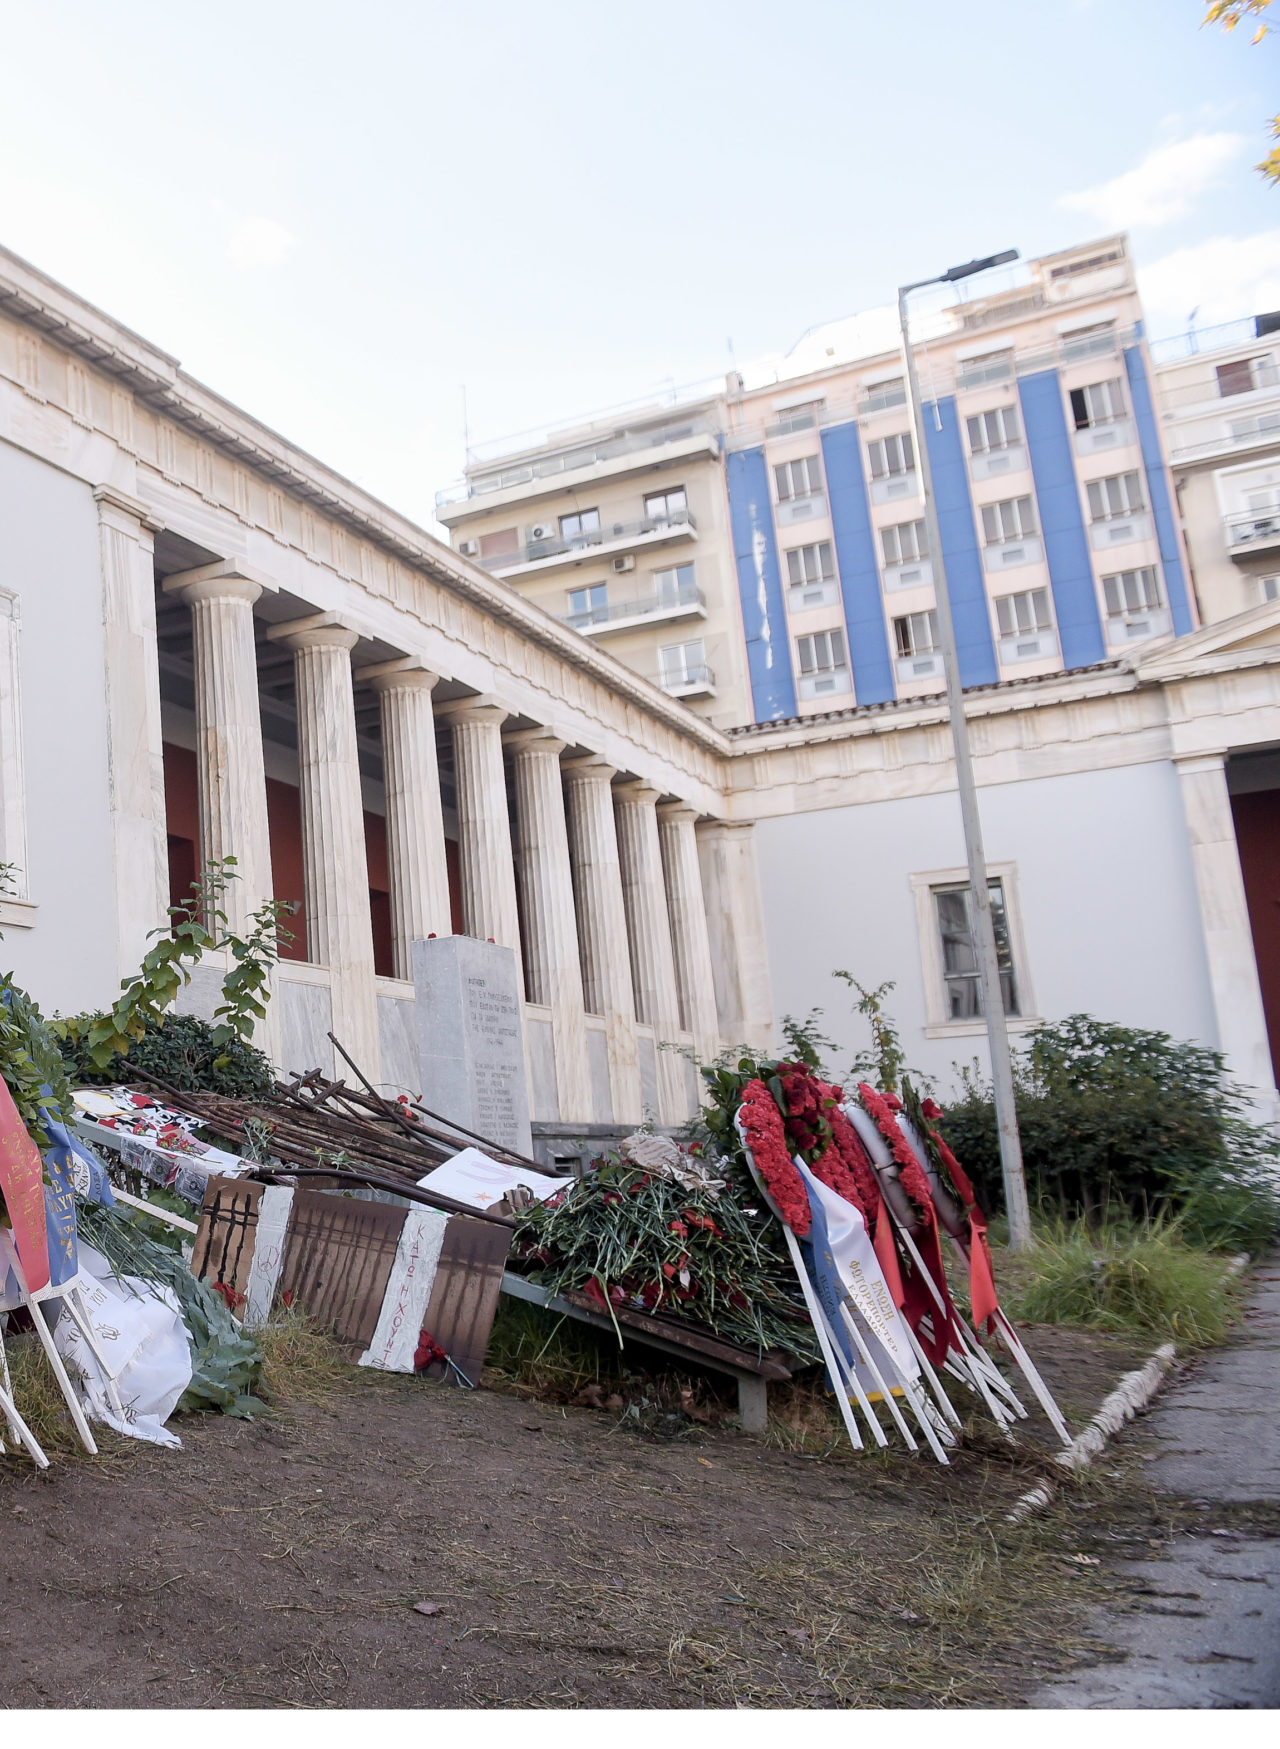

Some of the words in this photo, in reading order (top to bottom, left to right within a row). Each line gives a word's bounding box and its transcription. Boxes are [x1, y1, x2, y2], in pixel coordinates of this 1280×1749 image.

[407, 1224, 425, 1277] ΚΑΤΩ
[400, 1285, 408, 1296] Η
[848, 1260, 898, 1352] ΦΩΤΟΡΕΠΟΡΤΕΡ
[848, 1285, 882, 1336] ΕΛΛΑΔΟΣ
[871, 1280, 895, 1320] ΕΝΩΣΗ
